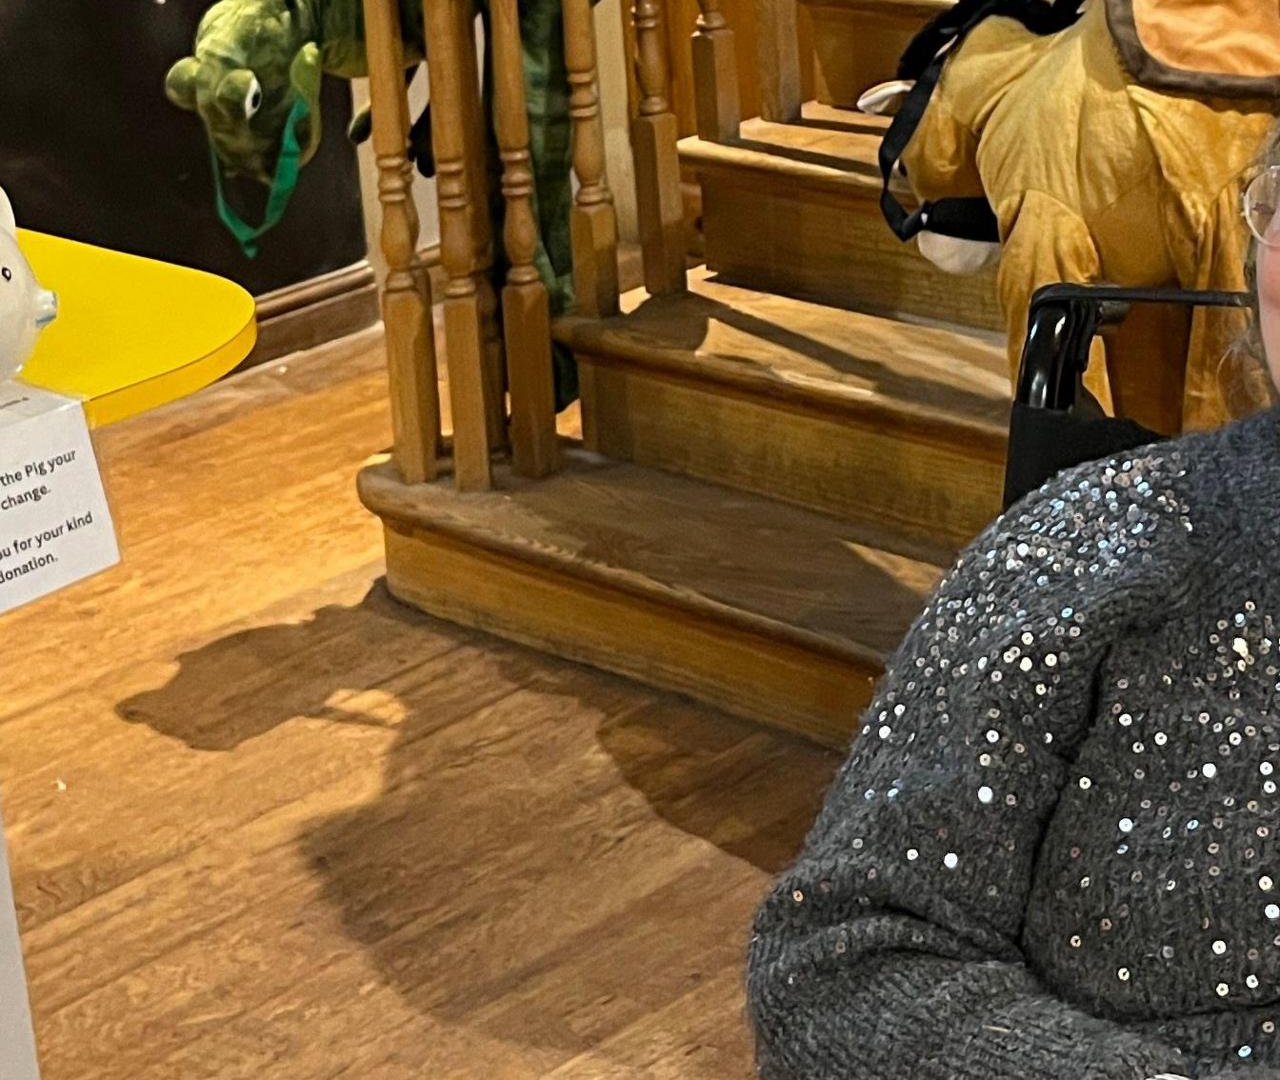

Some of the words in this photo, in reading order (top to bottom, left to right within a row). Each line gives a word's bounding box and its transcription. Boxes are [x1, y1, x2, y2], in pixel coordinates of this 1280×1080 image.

[0, 470, 23, 487] the
[24, 461, 47, 478] Pig
[48, 449, 77, 473] your
[1, 484, 52, 511] change.
[13, 536, 33, 555] for
[35, 524, 64, 547] your
[66, 511, 93, 532] kind
